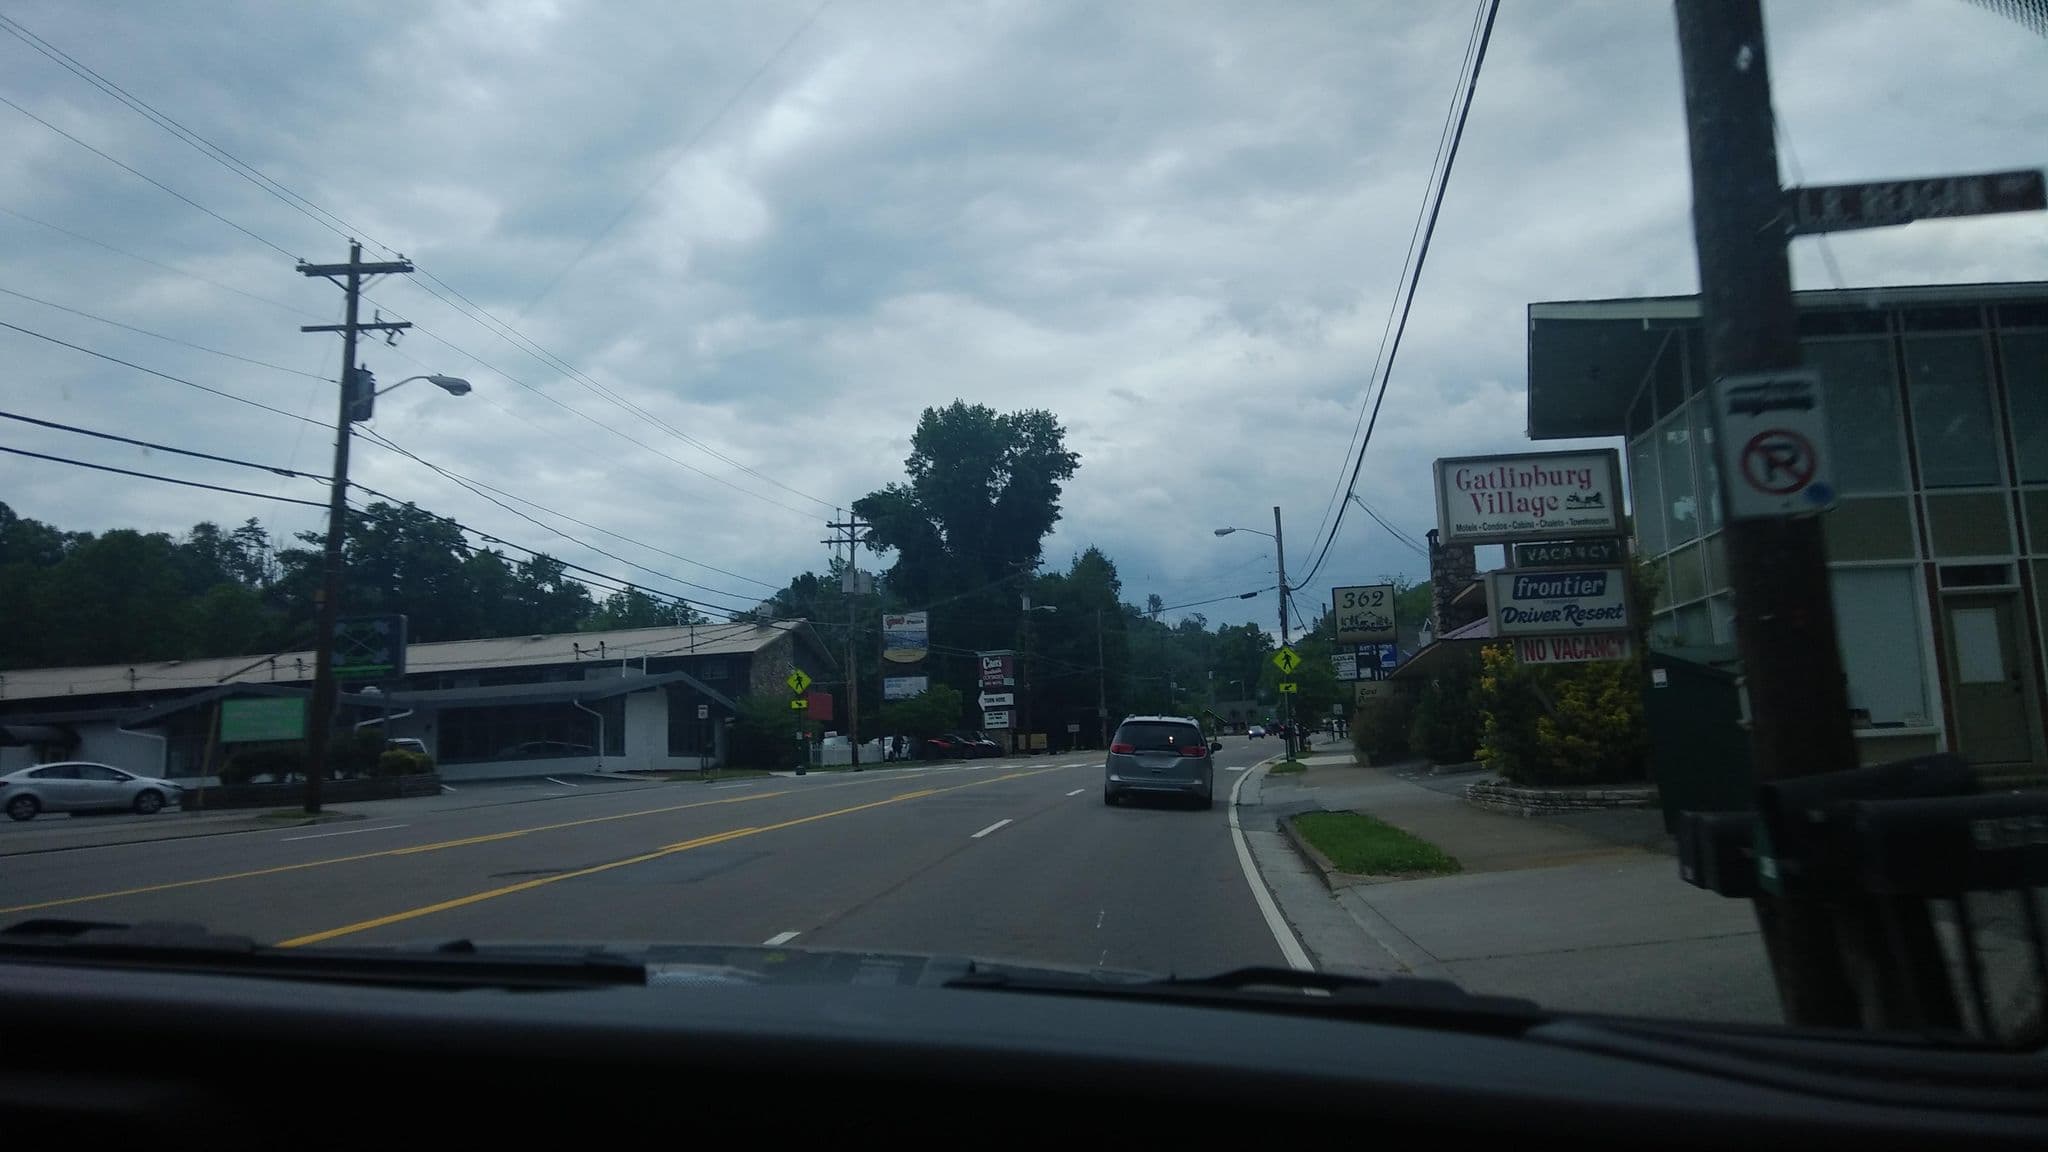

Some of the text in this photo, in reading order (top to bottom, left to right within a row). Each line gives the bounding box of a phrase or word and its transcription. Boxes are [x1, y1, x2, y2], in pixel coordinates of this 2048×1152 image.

[1456, 464, 1592, 491] Gatlinburg
[1471, 491, 1559, 518] Village
[1527, 546, 1610, 561] VACANCY
[1518, 576, 1604, 597] frontier
[1342, 590, 1384, 609] 362
[1523, 637, 1625, 662] NO VACANCY
